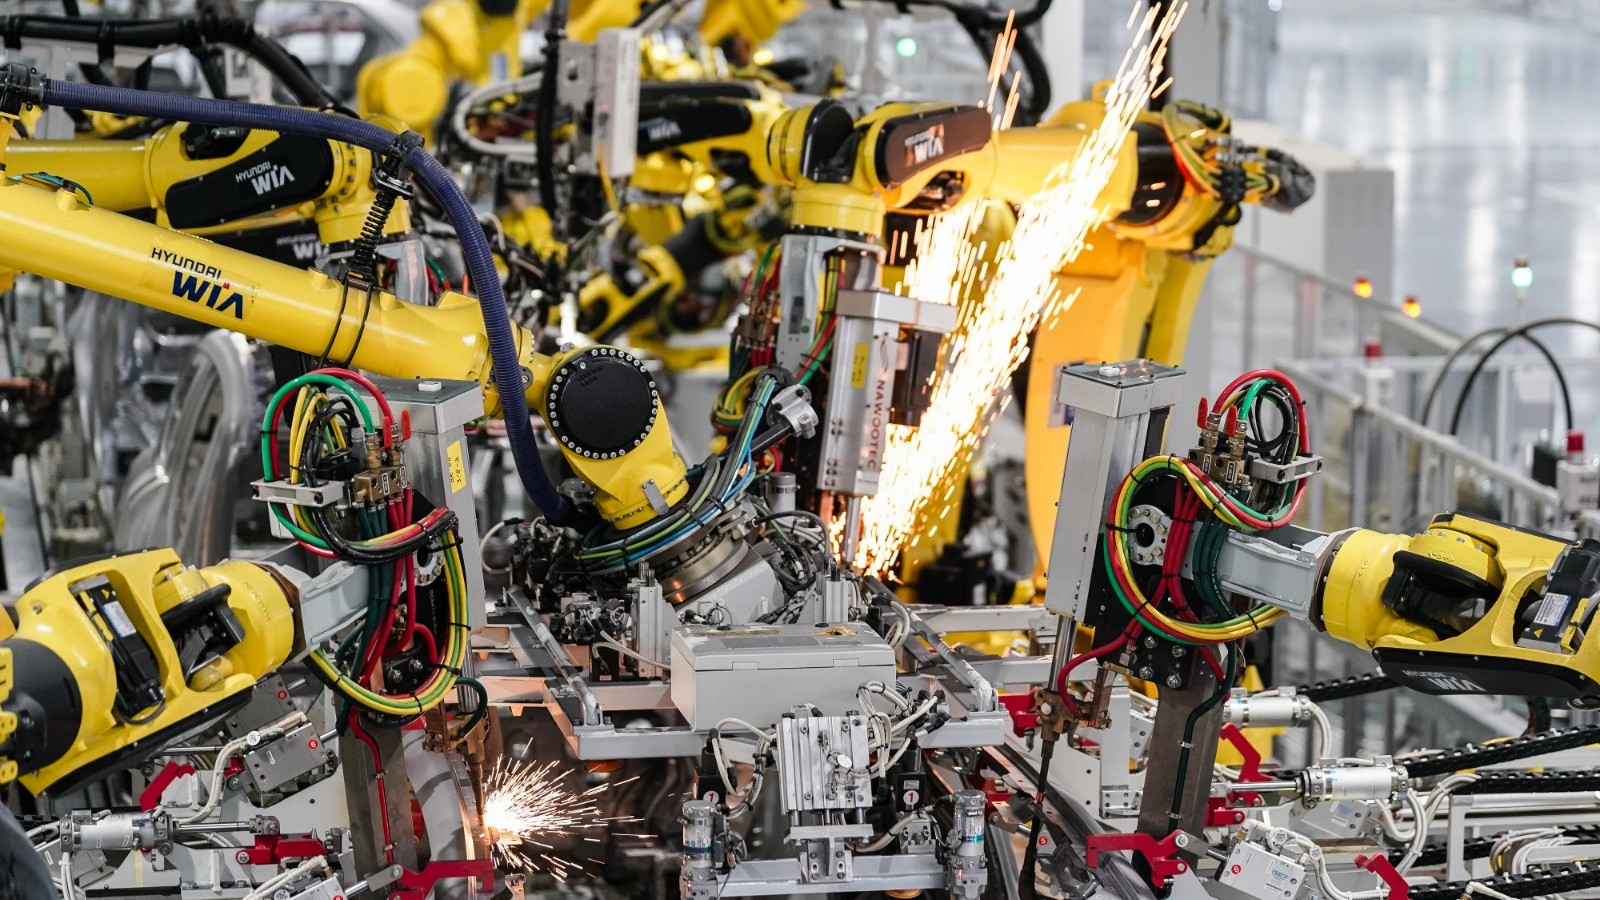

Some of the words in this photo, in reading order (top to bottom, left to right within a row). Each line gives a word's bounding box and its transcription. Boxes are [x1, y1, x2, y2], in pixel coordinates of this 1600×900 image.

[235, 161, 271, 183] HYUNDAI
[251, 164, 296, 195] WIA
[151, 247, 222, 280] HYUNDAI
[171, 270, 244, 320] WIA
[866, 379, 886, 470] NAWOOTEC
[1427, 676, 1487, 692] WIA
